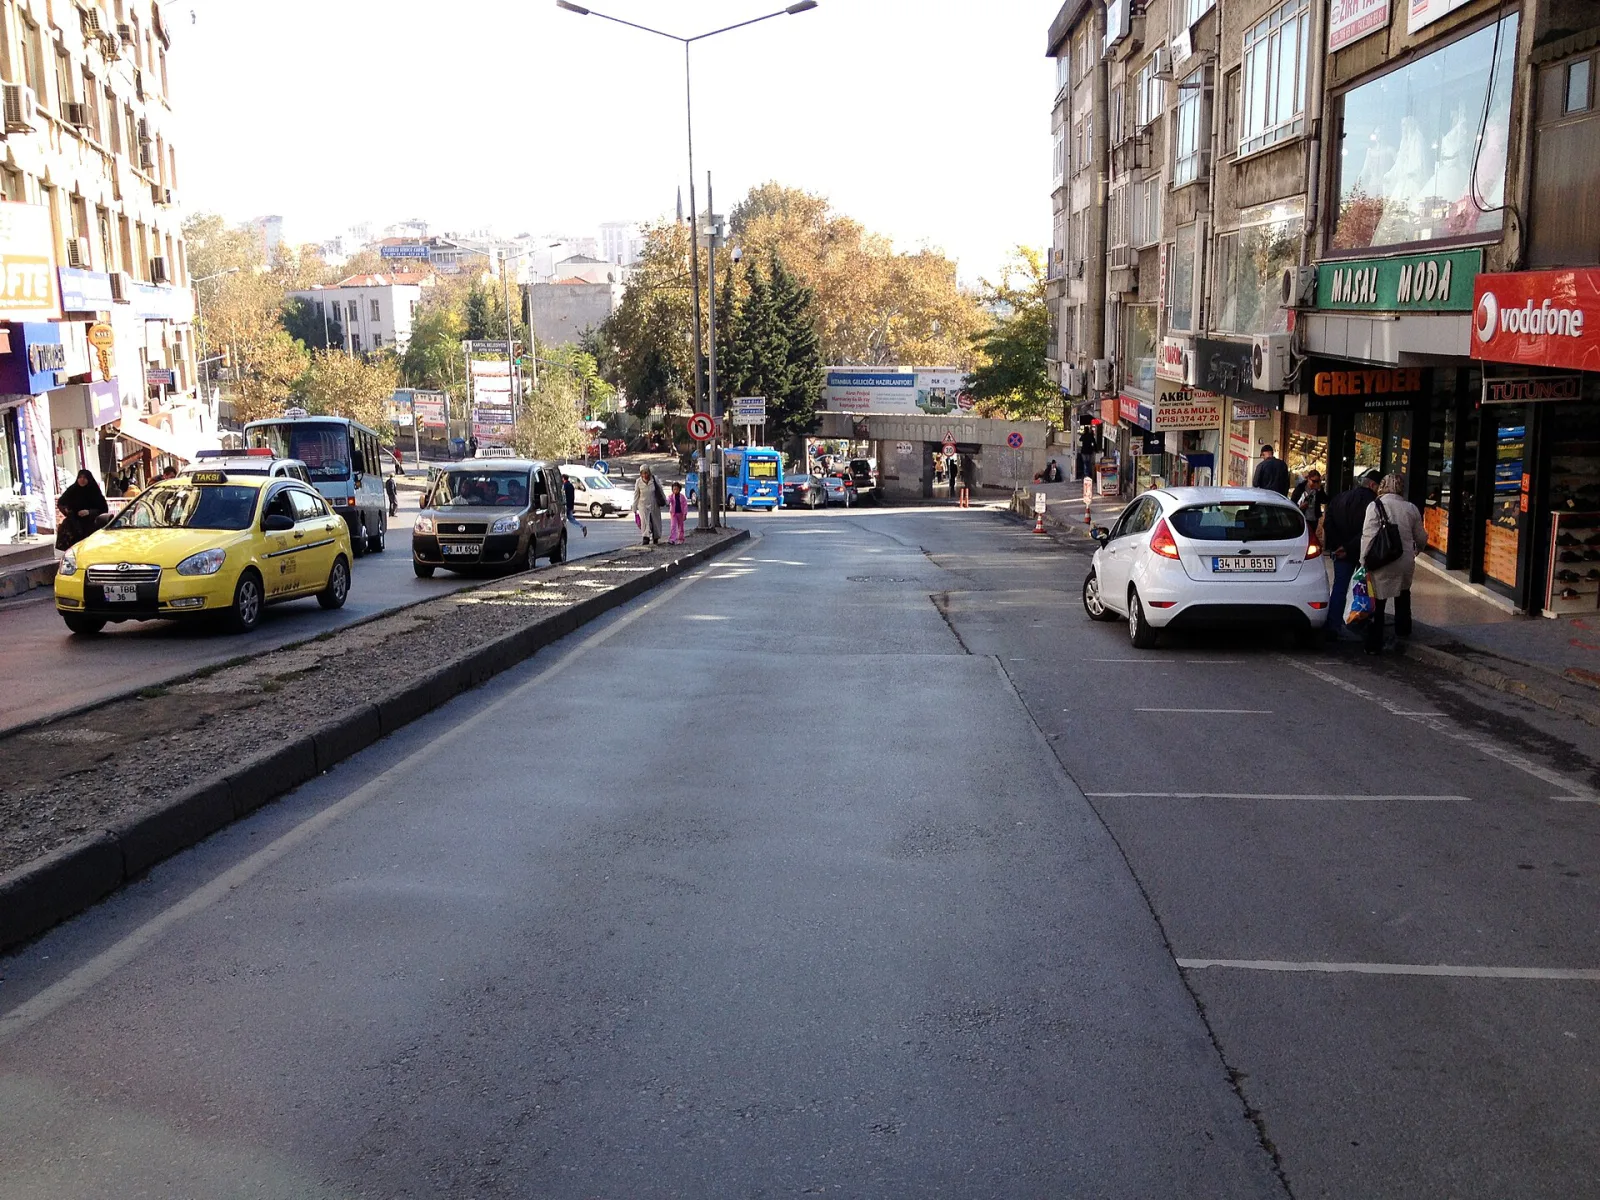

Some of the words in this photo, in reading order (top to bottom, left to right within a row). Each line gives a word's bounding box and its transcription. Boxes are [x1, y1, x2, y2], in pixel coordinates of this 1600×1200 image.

[1331, 267, 1378, 303] MASAL
[1397, 260, 1451, 302] MODA
[1501, 299, 1583, 337] vodafone
[1314, 367, 1421, 396] GREYDER
[1491, 379, 1576, 400] TÜTÜNCÜ
[1180, 415, 1195, 423] 374
[1191, 406, 1217, 414] MÜLK
[1219, 559, 1230, 568] 34
[1235, 559, 1246, 568] HJ
[1251, 559, 1274, 568] 8519
